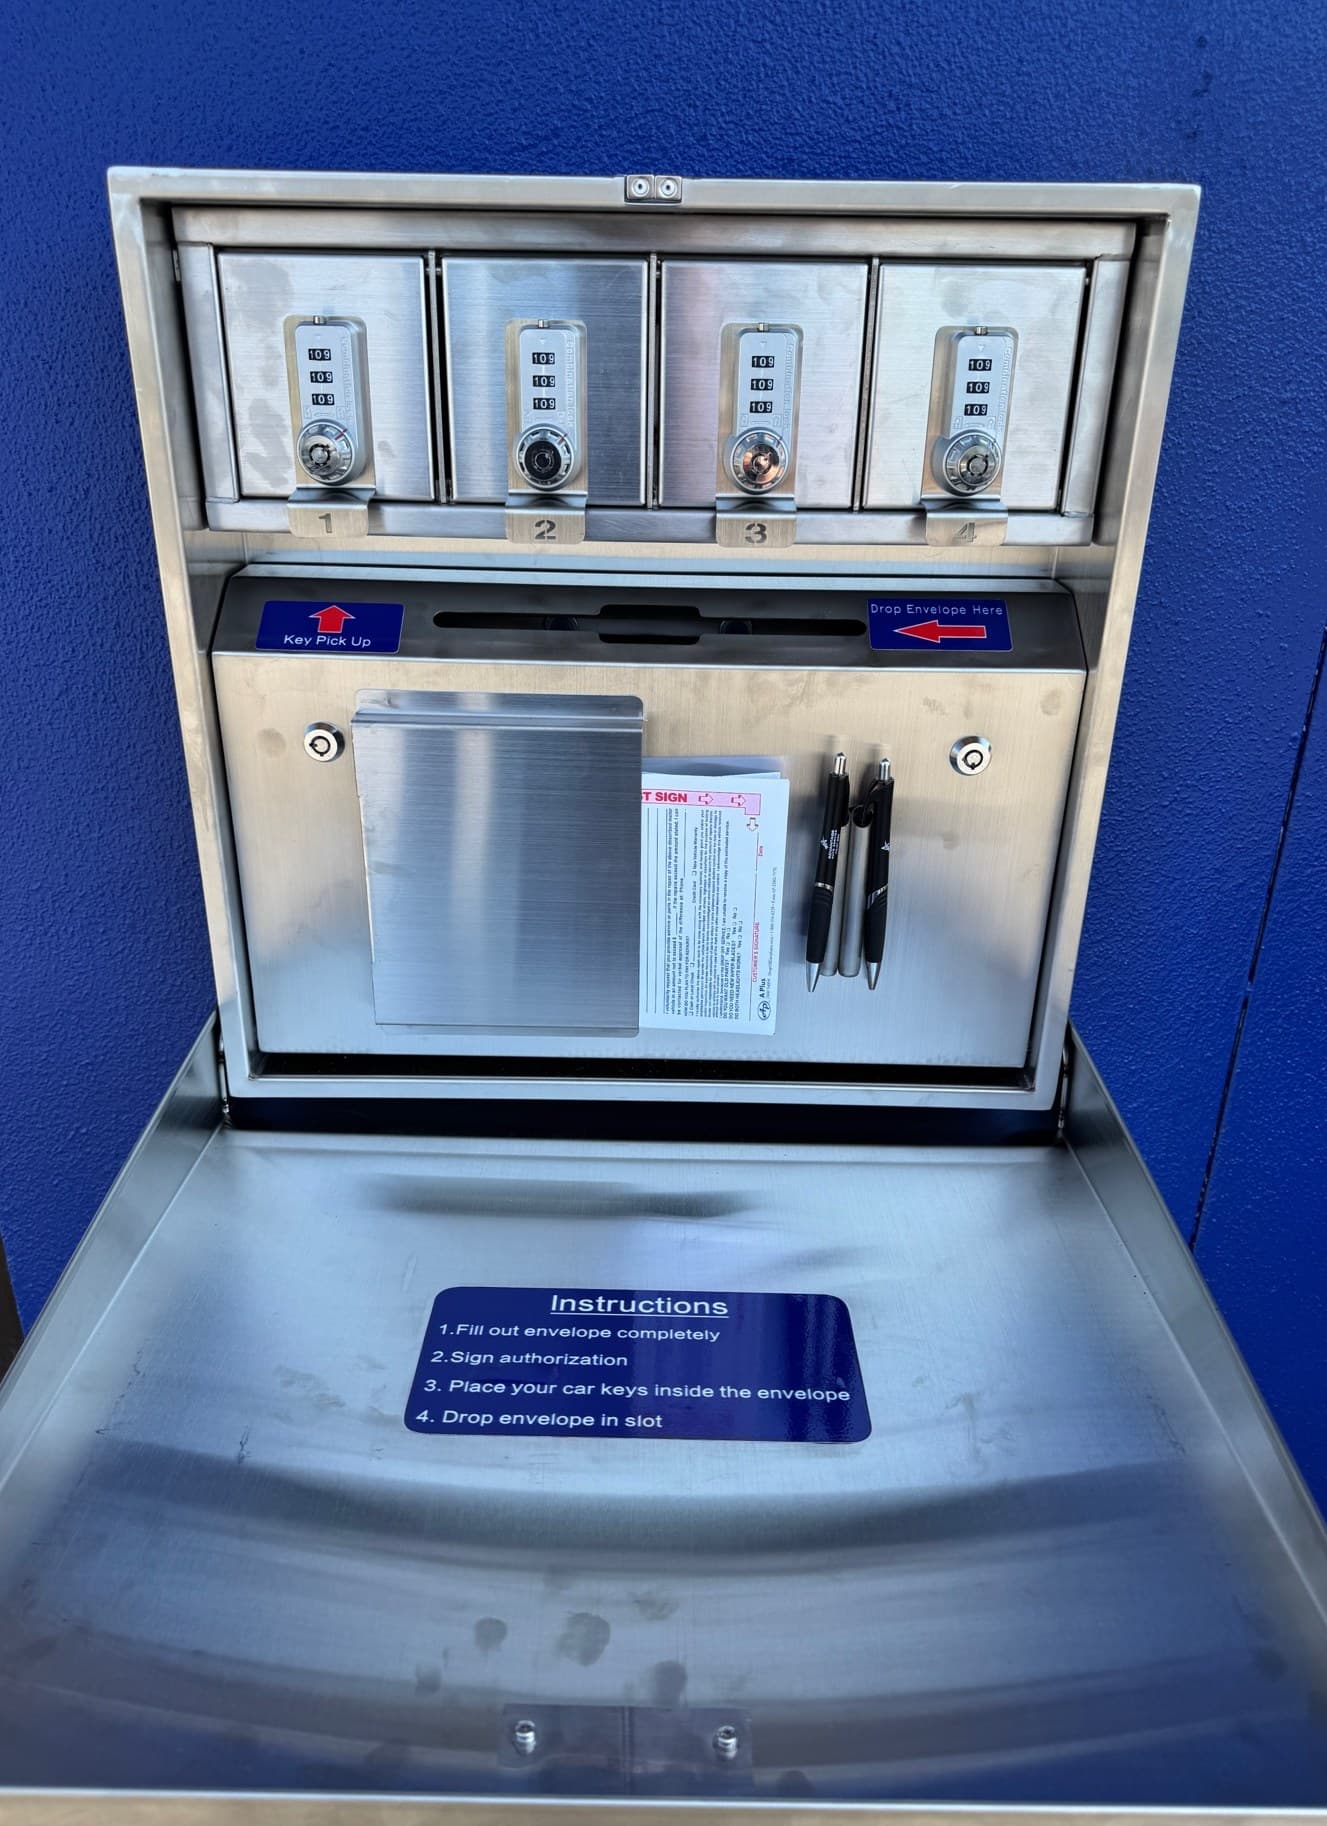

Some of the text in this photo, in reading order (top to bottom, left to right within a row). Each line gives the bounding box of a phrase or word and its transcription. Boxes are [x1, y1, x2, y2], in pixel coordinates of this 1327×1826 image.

[309, 350, 330, 360] 109
[533, 354, 554, 364] 109
[752, 357, 774, 367] 109
[969, 360, 991, 370] 109
[311, 372, 332, 382] 109
[534, 376, 555, 386] 109
[752, 380, 773, 390] 109
[967, 383, 989, 393] 109
[313, 395, 334, 404] 109
[534, 399, 555, 409] 109
[750, 402, 772, 412] 109
[965, 405, 987, 415] 109
[318, 512, 333, 534] 1
[534, 520, 556, 540] 2
[744, 522, 768, 544] 3
[954, 522, 977, 543] 4
[870, 604, 1003, 616] Drop Envelope Here
[284, 634, 372, 648] Key Pick Up
[655, 792, 688, 802] SIGN
[551, 1294, 728, 1316] Instructions
[489, 1326, 519, 1336] out
[524, 1327, 612, 1340] envelope
[617, 1328, 720, 1342] completely
[500, 1353, 628, 1366] authorization
[424, 1380, 850, 1403] 3. Place your car keys inside the envelope
[416, 1410, 663, 1428] 4. Drop envelope in slot
